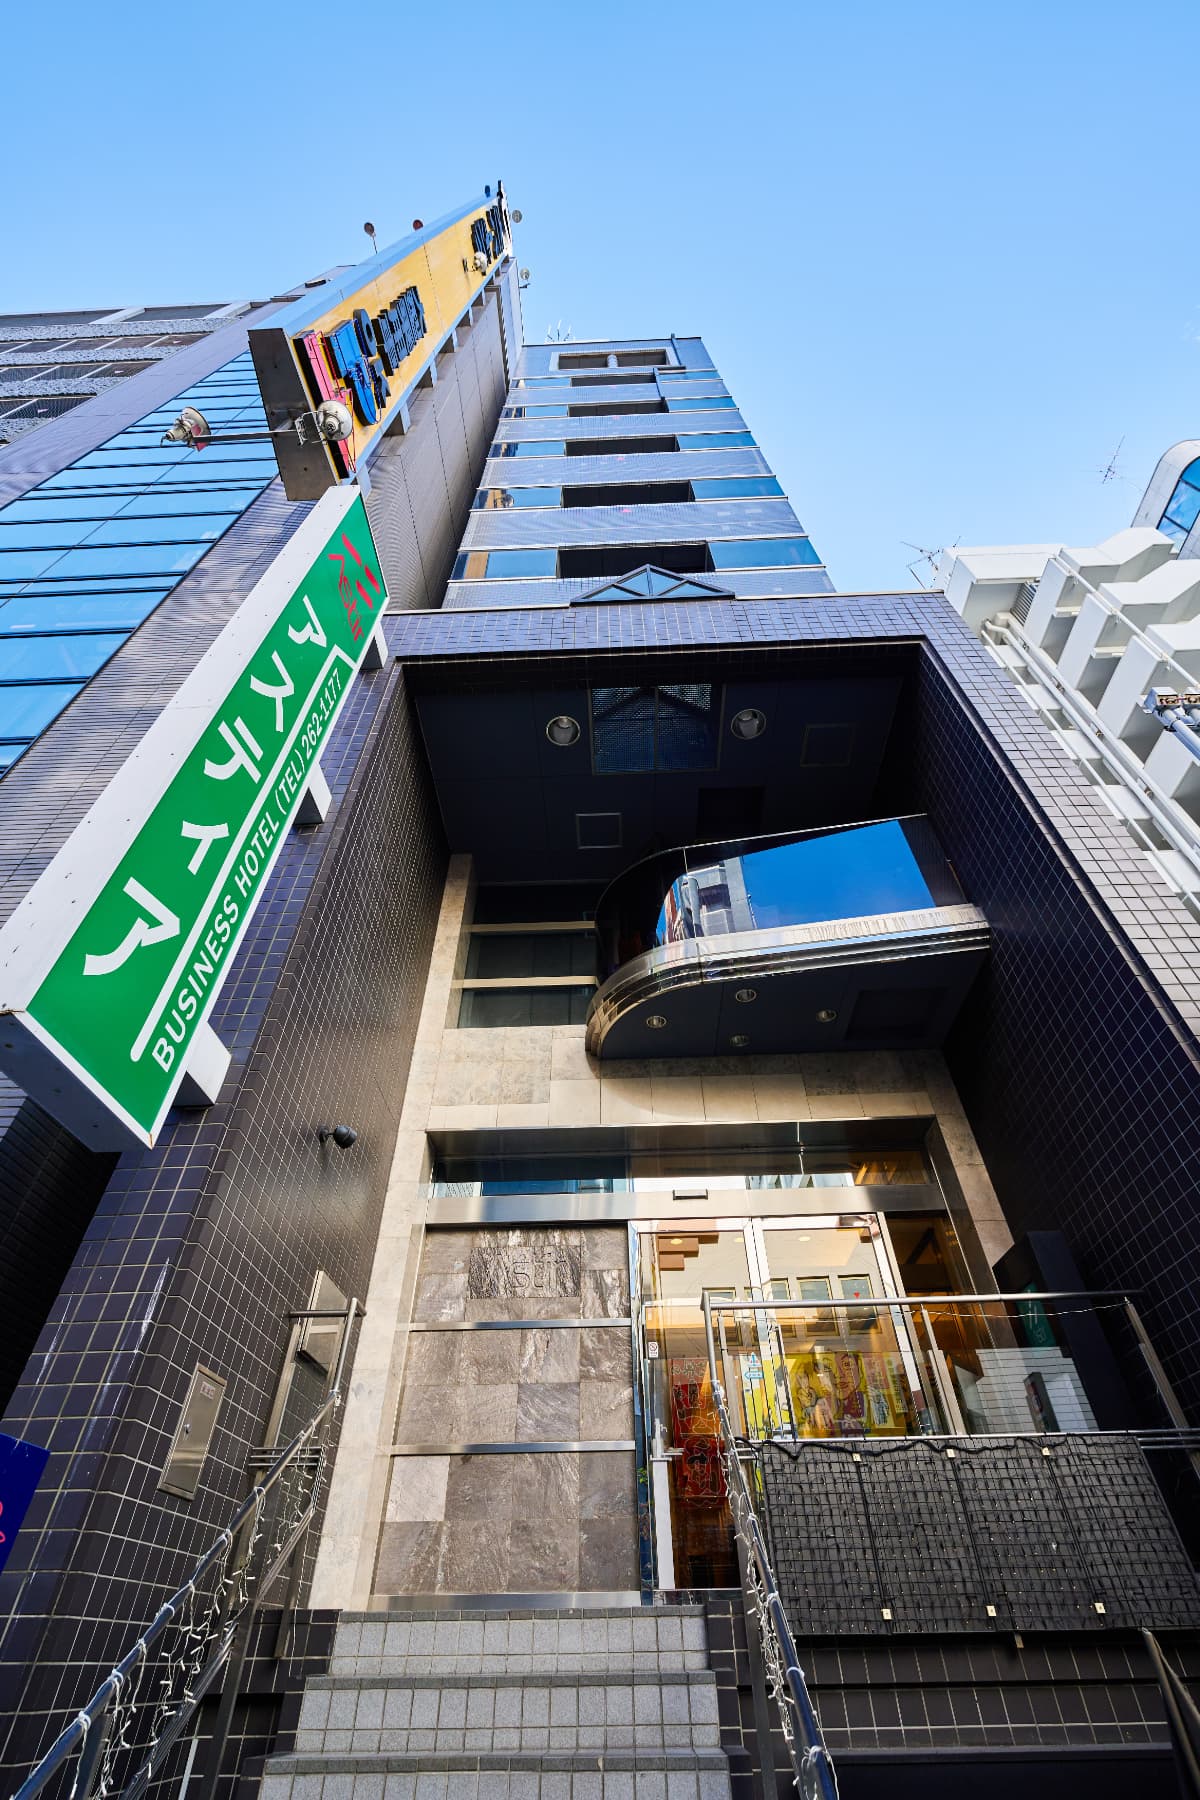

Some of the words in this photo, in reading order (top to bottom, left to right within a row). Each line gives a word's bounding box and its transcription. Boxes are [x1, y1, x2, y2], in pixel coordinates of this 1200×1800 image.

[84, 596, 326, 975] アスティア
[152, 896, 238, 1072] BUSINESS
[235, 813, 279, 897] HOTEL
[276, 750, 304, 814] (TEL)
[302, 669, 340, 758] 262-1177
